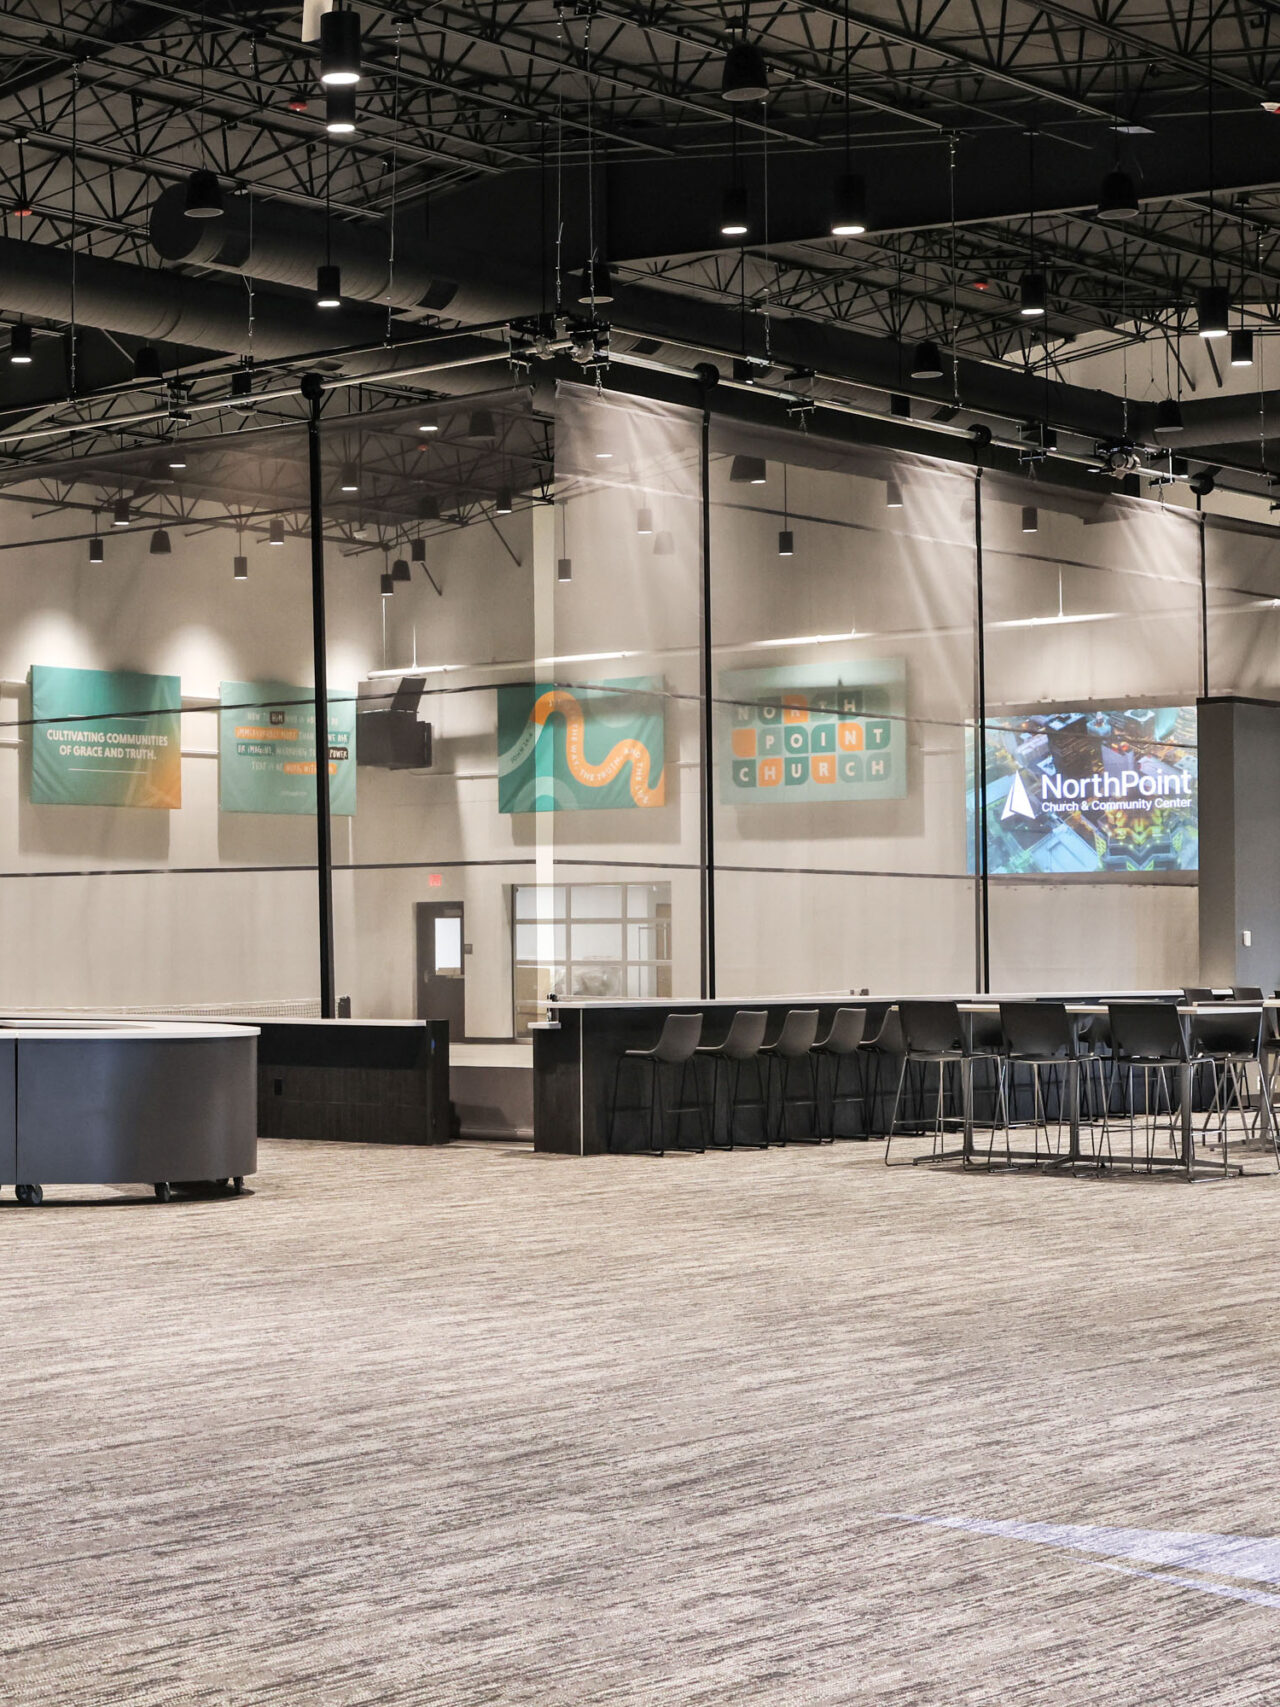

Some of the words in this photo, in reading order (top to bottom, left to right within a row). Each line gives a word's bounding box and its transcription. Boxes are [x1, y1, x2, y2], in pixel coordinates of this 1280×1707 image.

[737, 698, 856, 721] NORTH
[46, 729, 105, 743] CULTIVATING
[106, 733, 168, 747] COMMUNITIES
[765, 728, 883, 749] POINT
[59, 744, 72, 756] OF
[73, 745, 103, 757] GRACE
[104, 747, 124, 758] AND
[125, 748, 157, 760] TRUTH.
[739, 760, 885, 782] CHURCH
[1041, 768, 1192, 800] NorthPoint
[1041, 800, 1079, 813] Church
[1081, 801, 1090, 811] &
[1091, 798, 1152, 813] Community
[1154, 797, 1192, 809] Center
